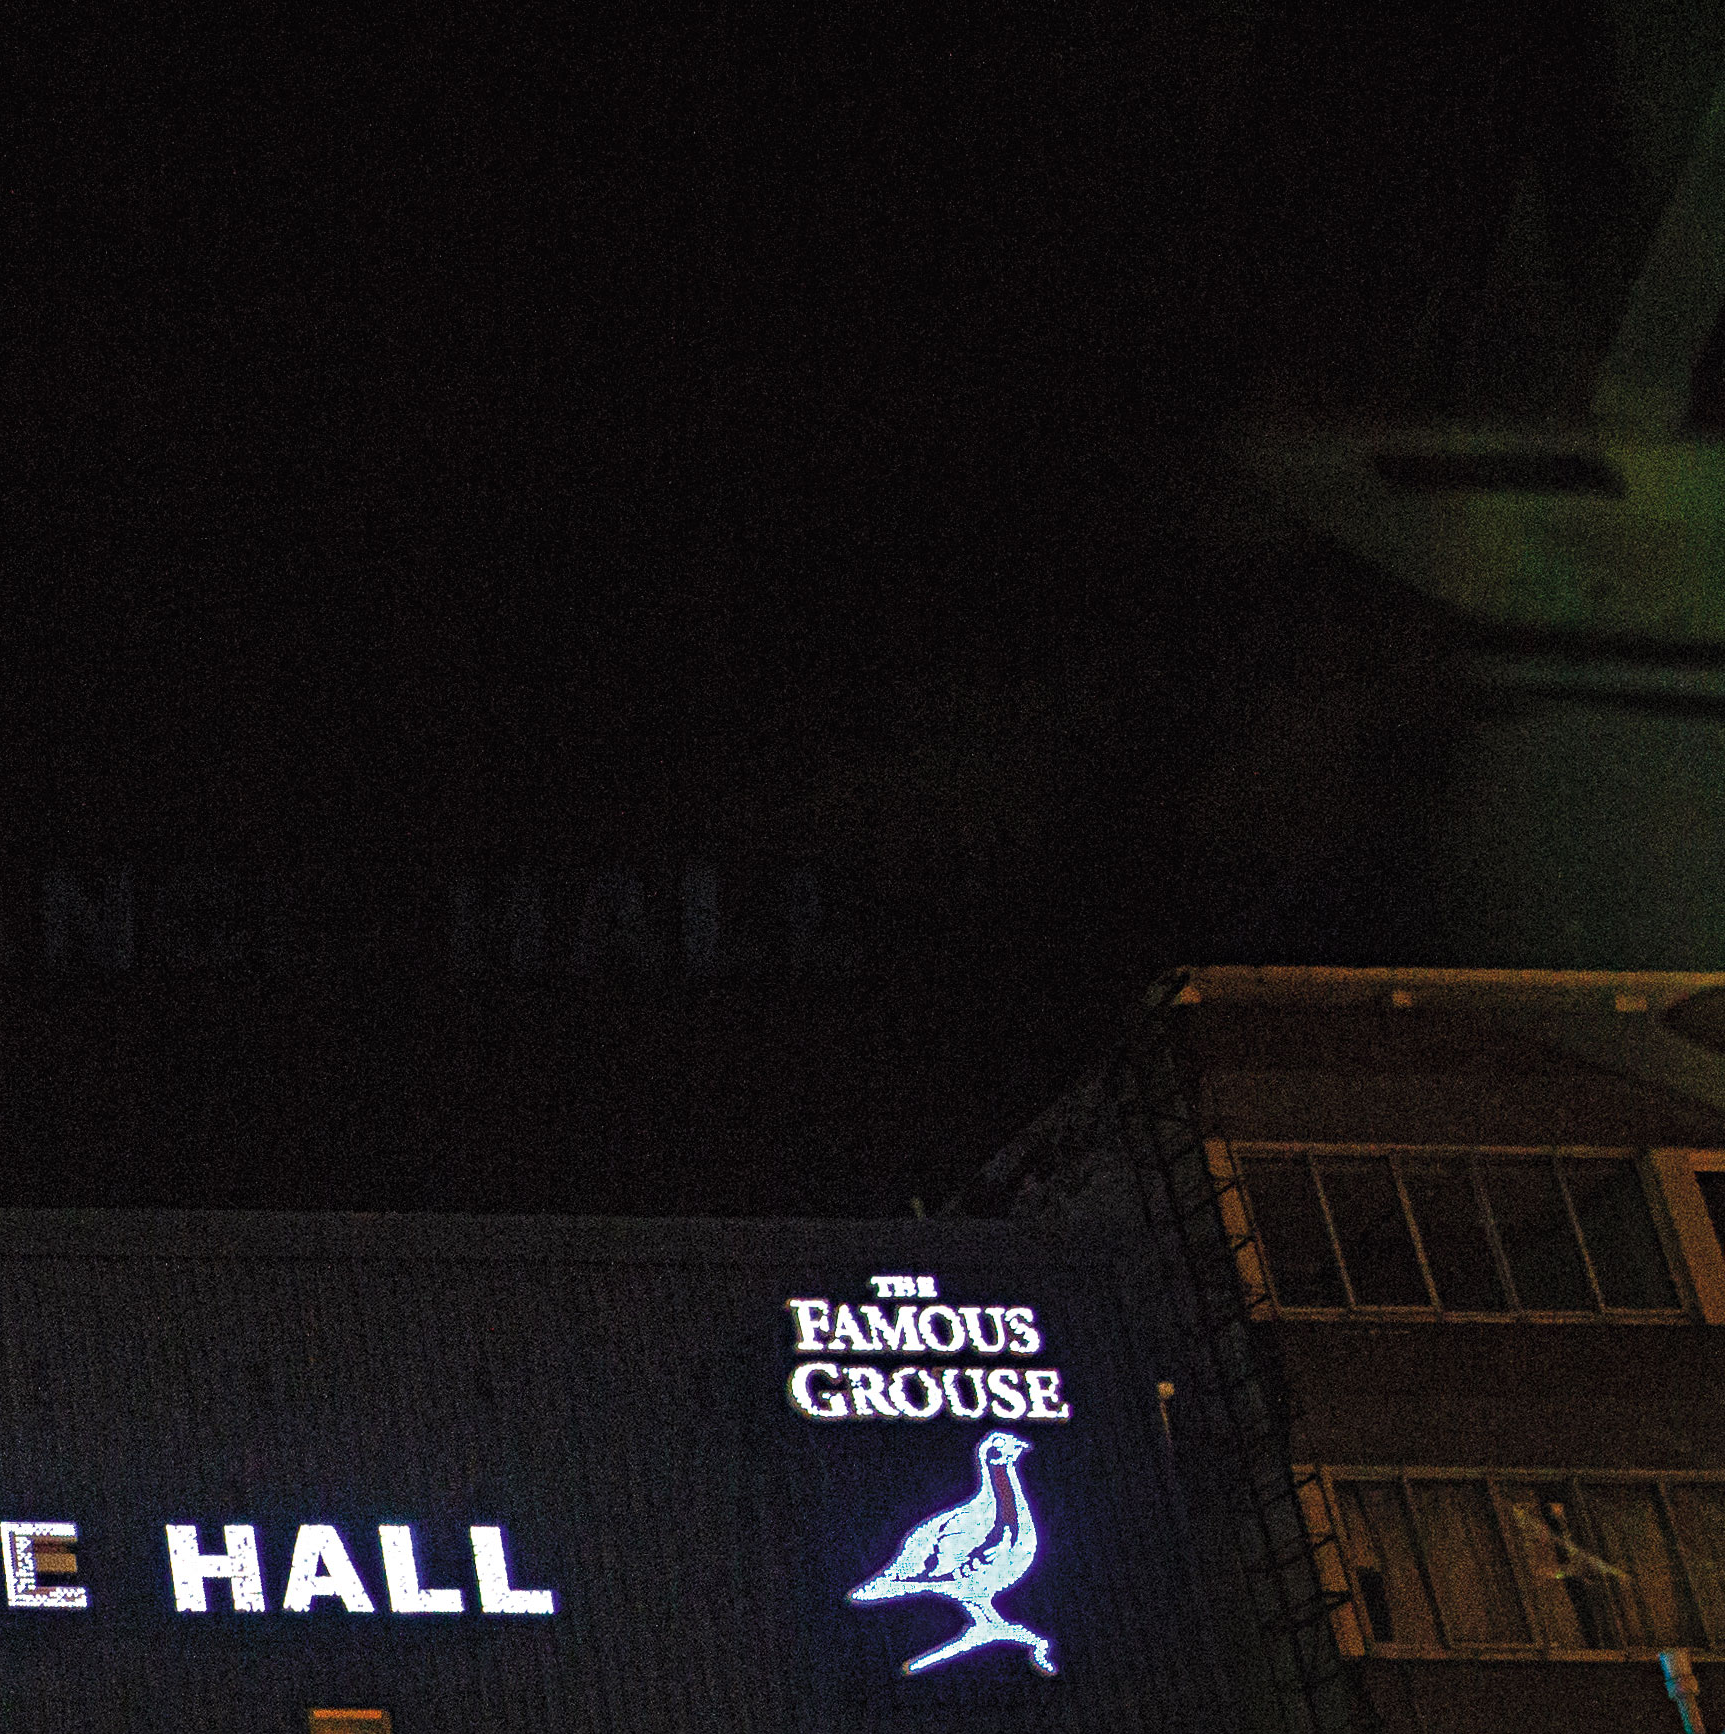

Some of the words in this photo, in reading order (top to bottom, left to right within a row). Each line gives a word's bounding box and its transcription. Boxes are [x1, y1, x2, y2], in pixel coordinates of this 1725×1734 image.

[869, 1275, 939, 1298] THE
[789, 1299, 1041, 1354] FAMOUS
[790, 1361, 1070, 1420] GROUSE
[164, 1522, 556, 1616] HALL
